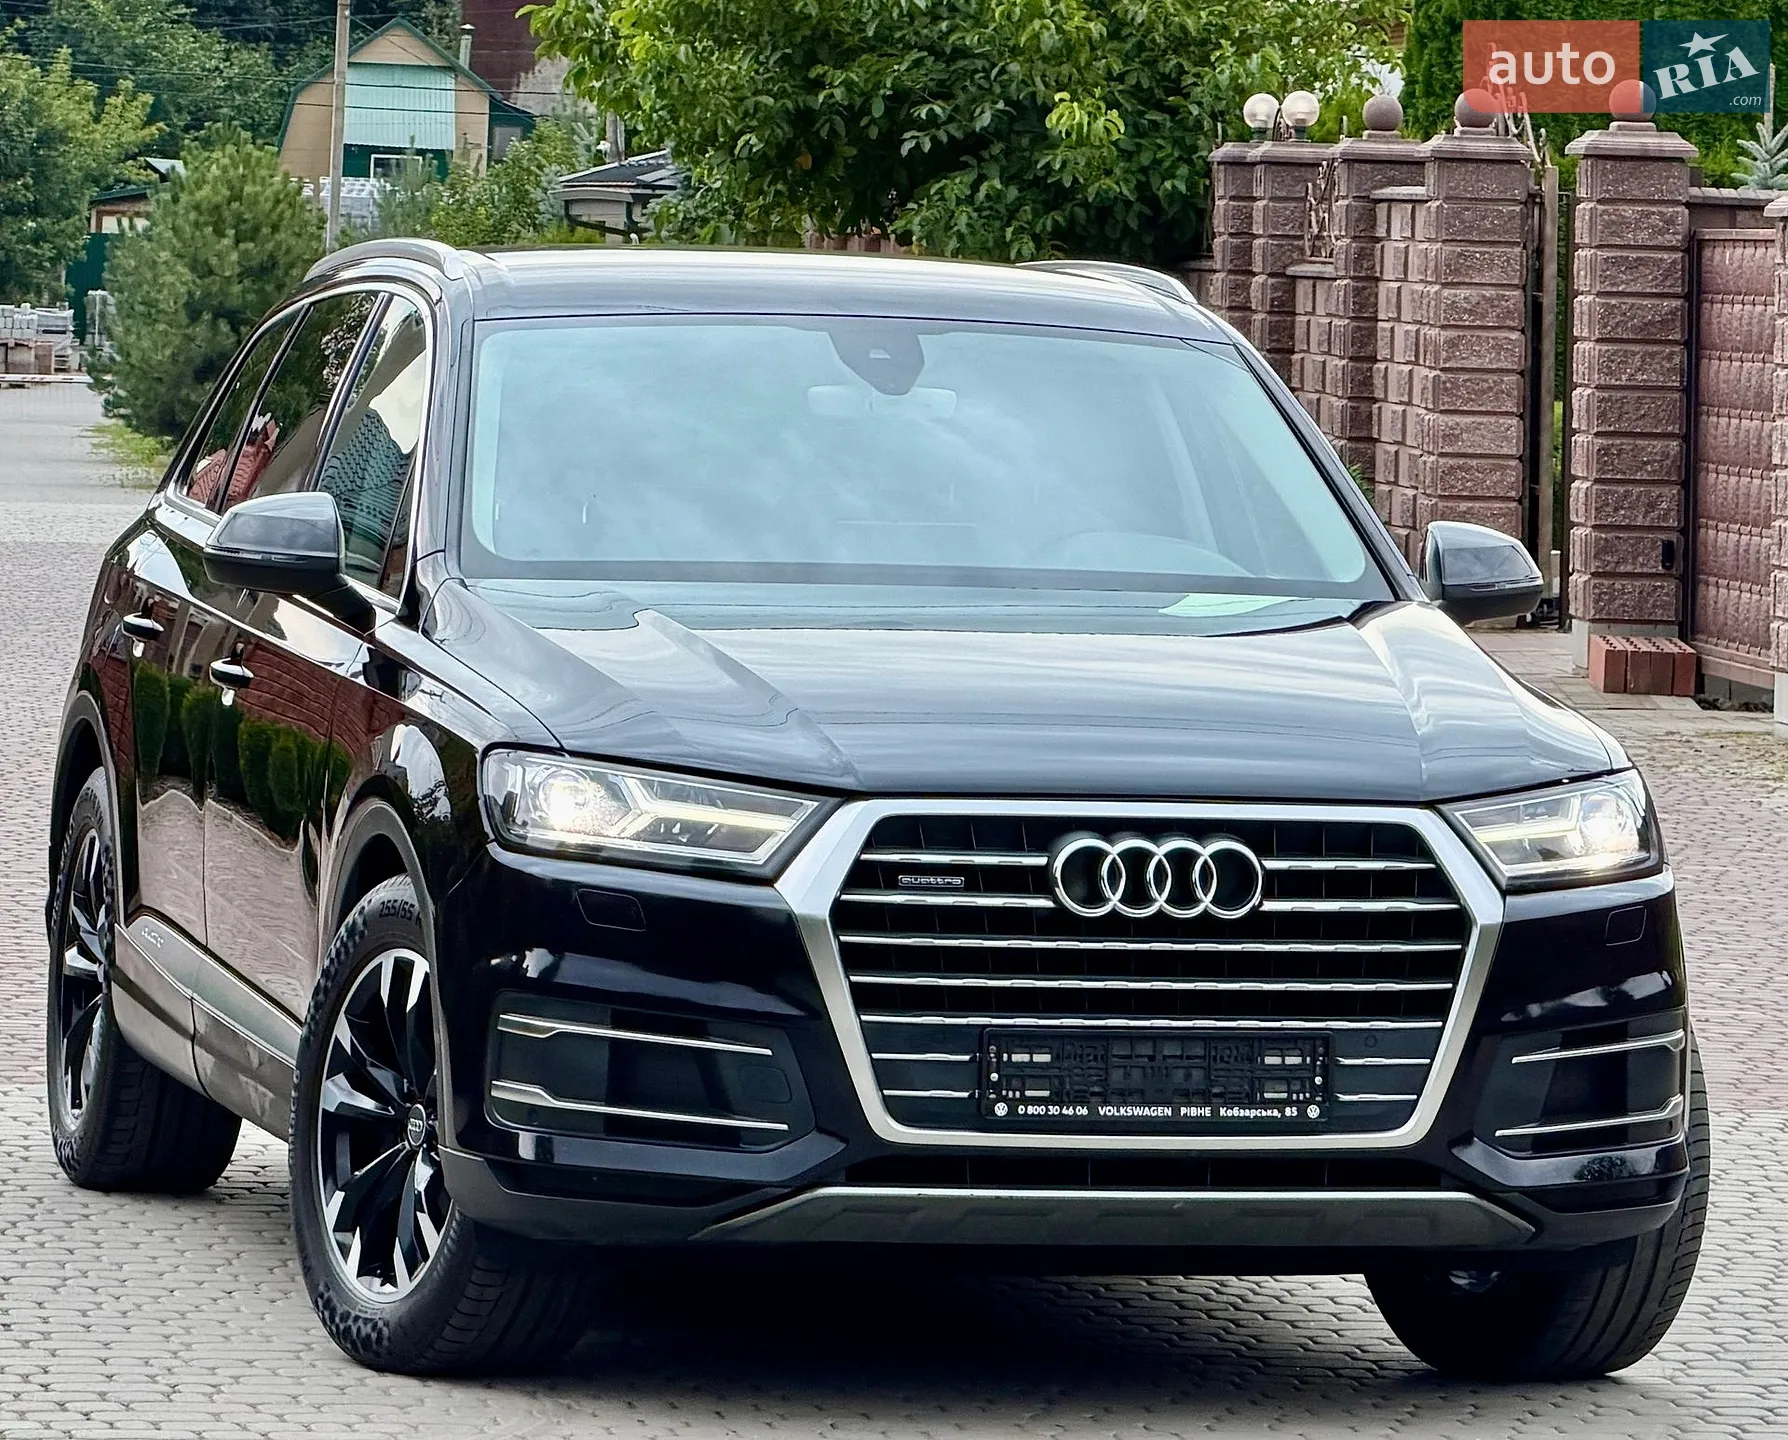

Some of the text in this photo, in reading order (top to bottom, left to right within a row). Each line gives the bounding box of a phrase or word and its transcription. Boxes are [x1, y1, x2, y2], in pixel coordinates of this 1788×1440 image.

[901, 877, 962, 885] quattro
[379, 899, 415, 921] 255/55
[1017, 1105, 1088, 1116] 0 800 30 46 06
[1098, 1105, 1172, 1117] VOLKSWAGEN
[1219, 1106, 1298, 1118] Кобзарська, 85
